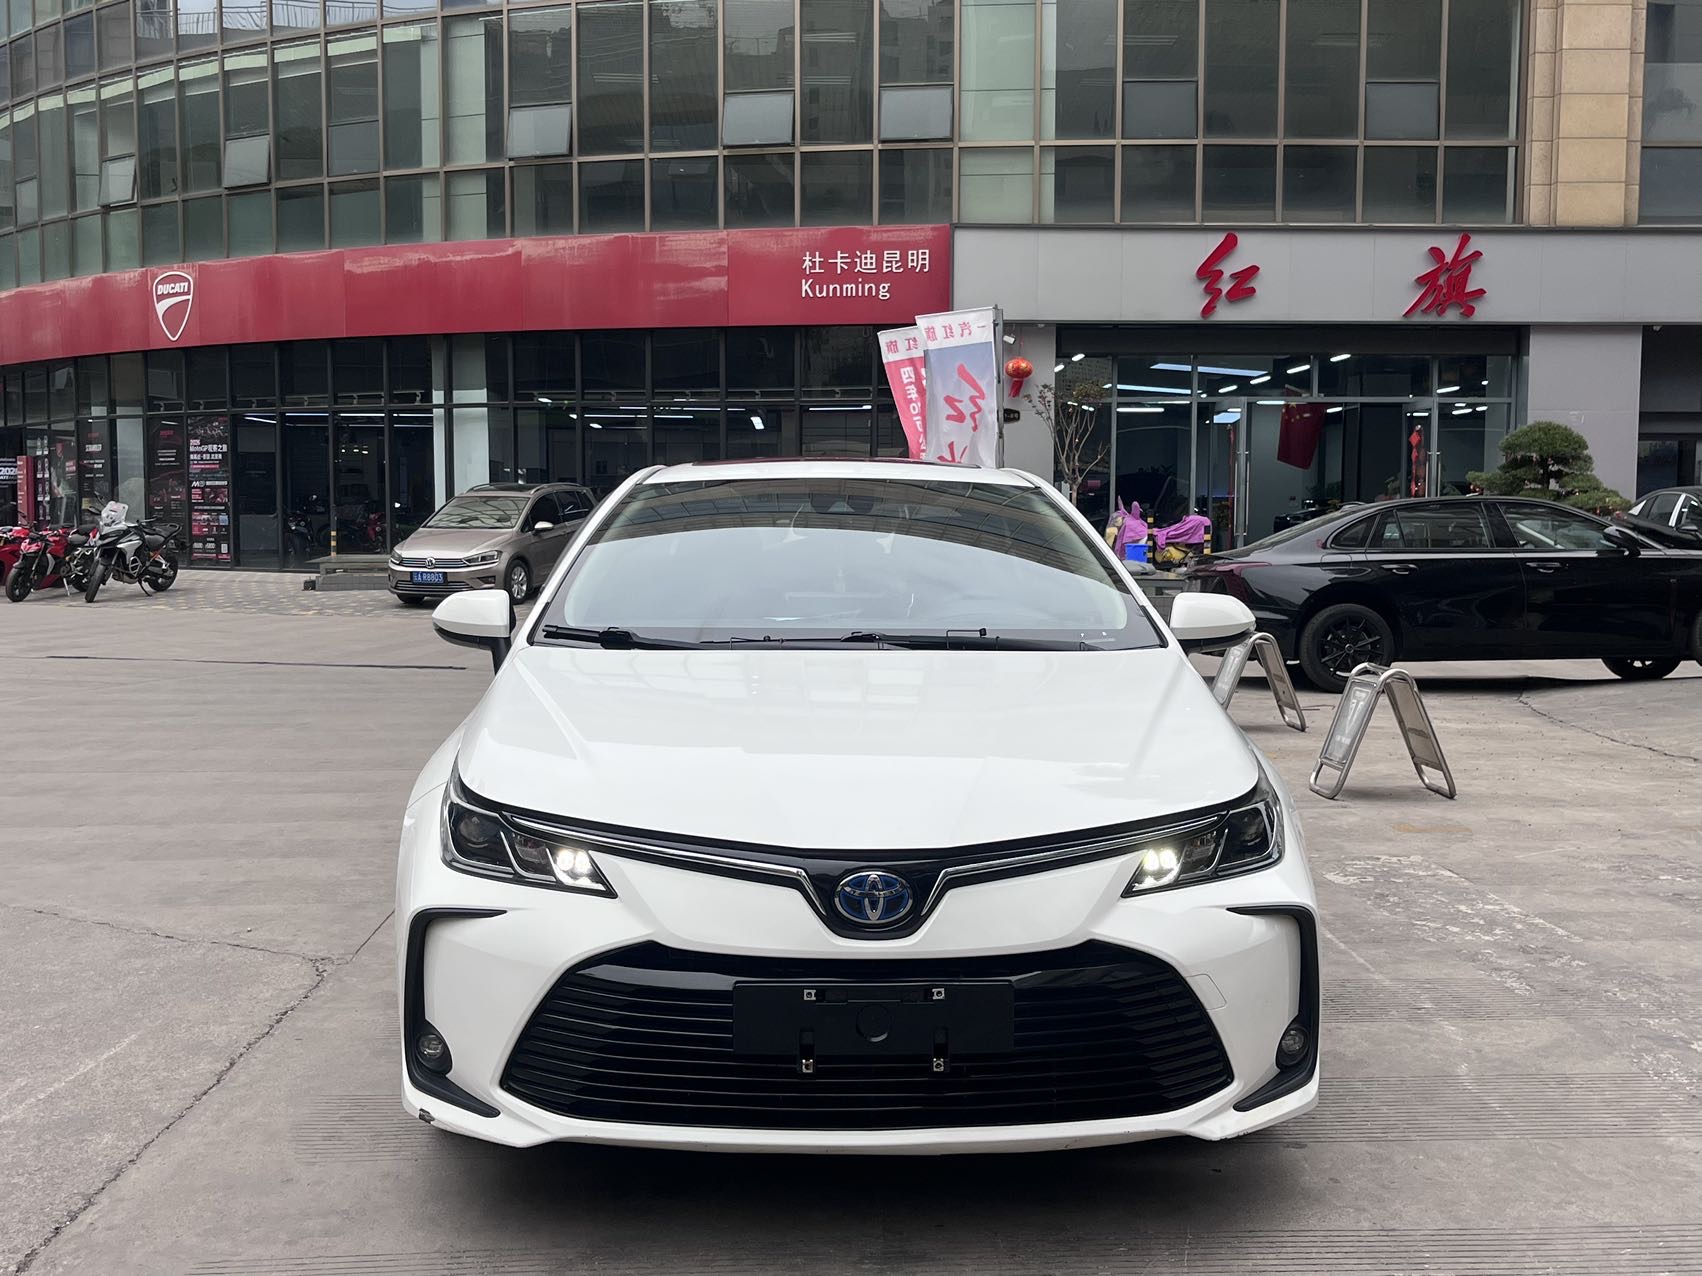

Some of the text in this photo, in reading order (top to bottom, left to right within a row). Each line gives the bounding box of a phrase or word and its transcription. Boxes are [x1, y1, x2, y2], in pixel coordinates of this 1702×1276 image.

[802, 249, 930, 274] 杜卡迪昆明
[157, 282, 189, 295] DUCATI
[801, 278, 891, 300] Kunming
